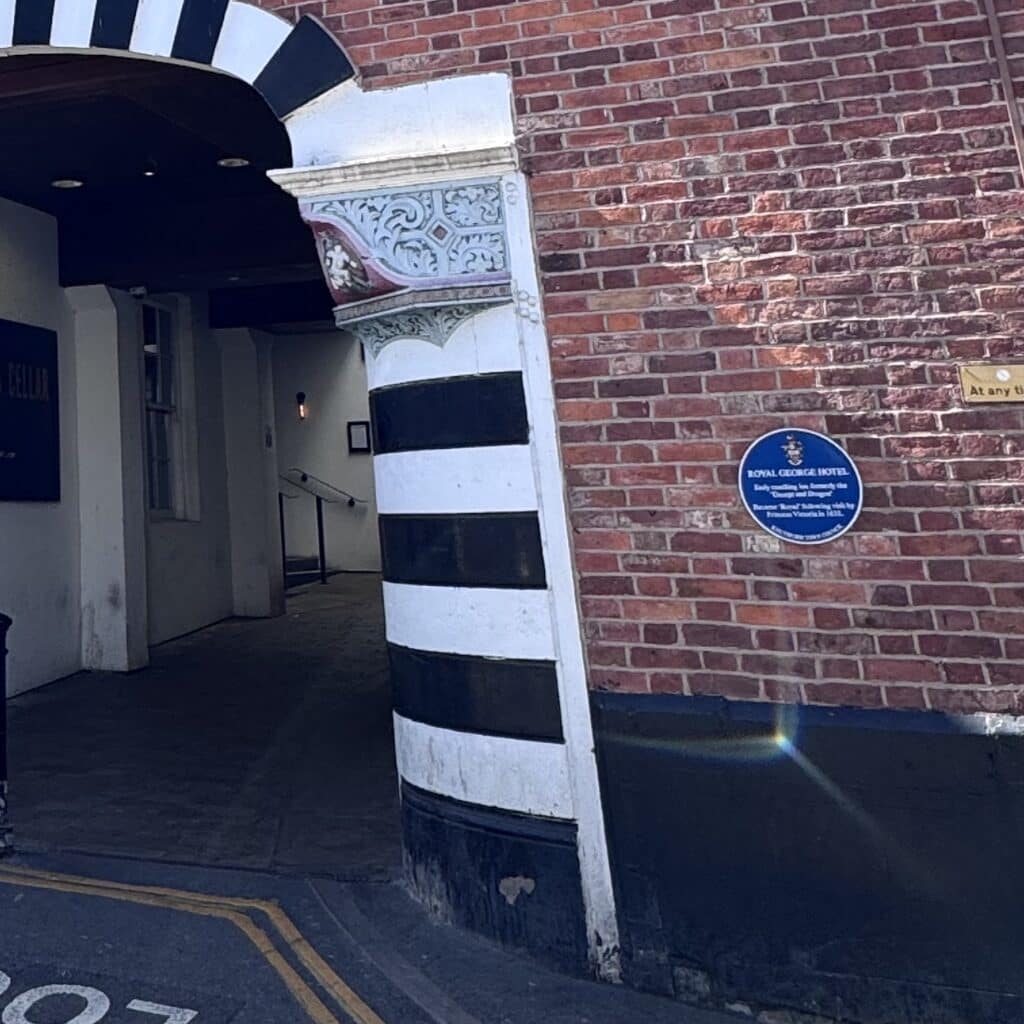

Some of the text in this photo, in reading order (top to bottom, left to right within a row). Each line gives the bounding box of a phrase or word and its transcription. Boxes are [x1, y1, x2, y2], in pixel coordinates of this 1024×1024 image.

[7, 361, 49, 401] CELLAR
[970, 385, 984, 396] At
[988, 387, 1010, 397] any
[747, 467, 850, 478] ROYAL GEORGE HOTEL
